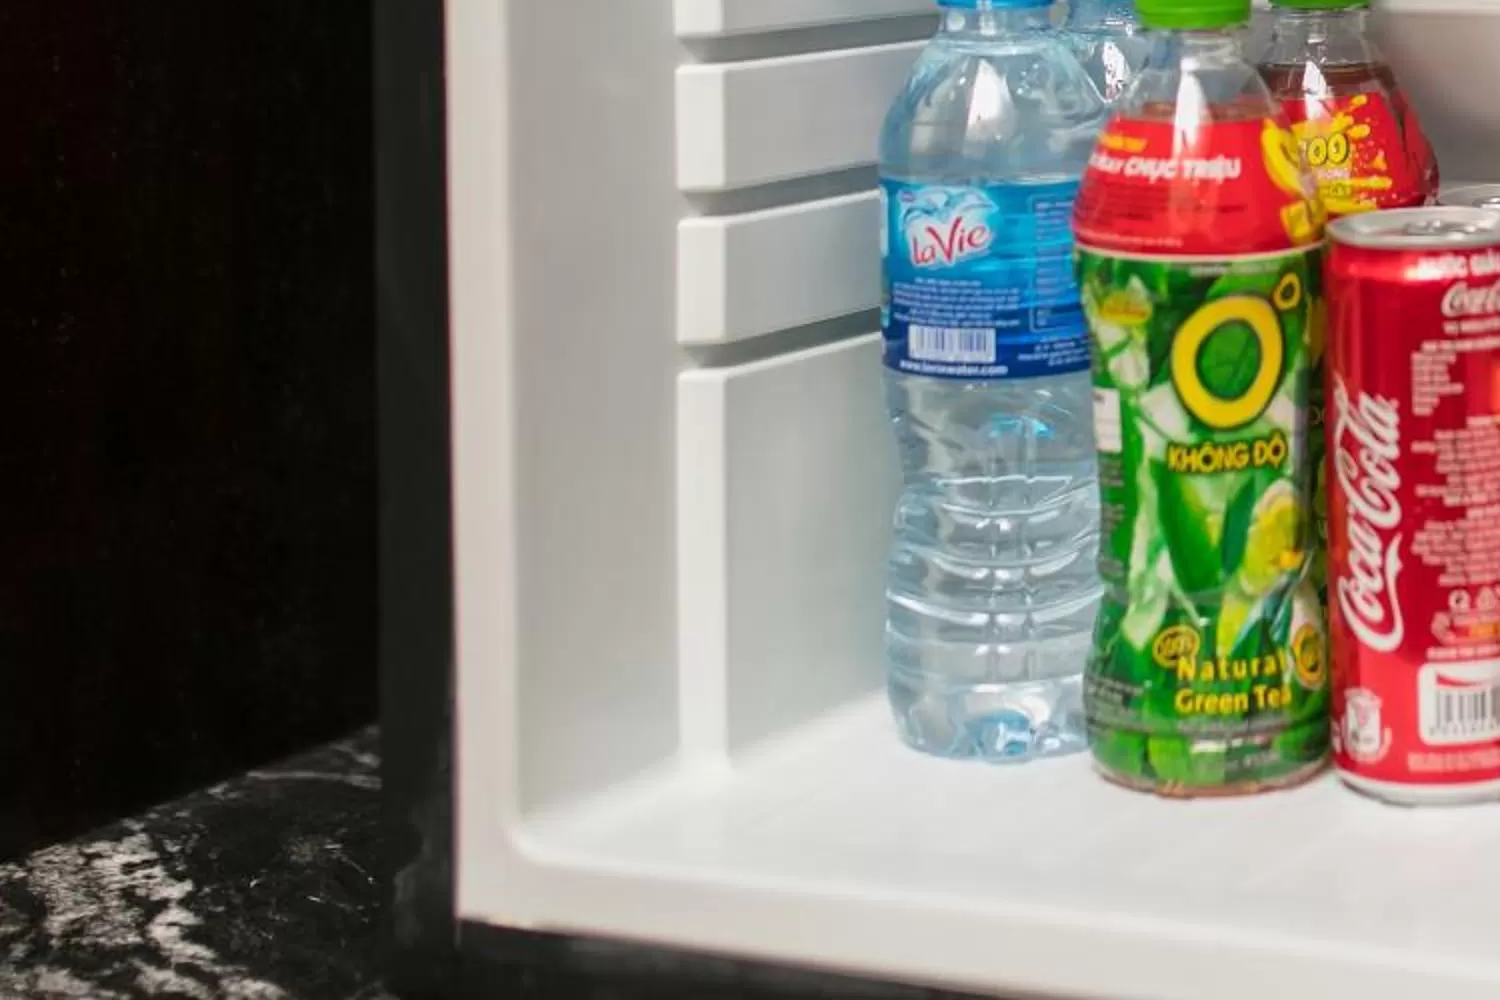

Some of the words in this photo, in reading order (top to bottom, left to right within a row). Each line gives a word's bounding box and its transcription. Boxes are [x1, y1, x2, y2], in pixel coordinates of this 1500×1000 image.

[1177, 648, 1286, 681] Natural
[1175, 688, 1250, 715] Green
[1253, 683, 1293, 709] Tea
